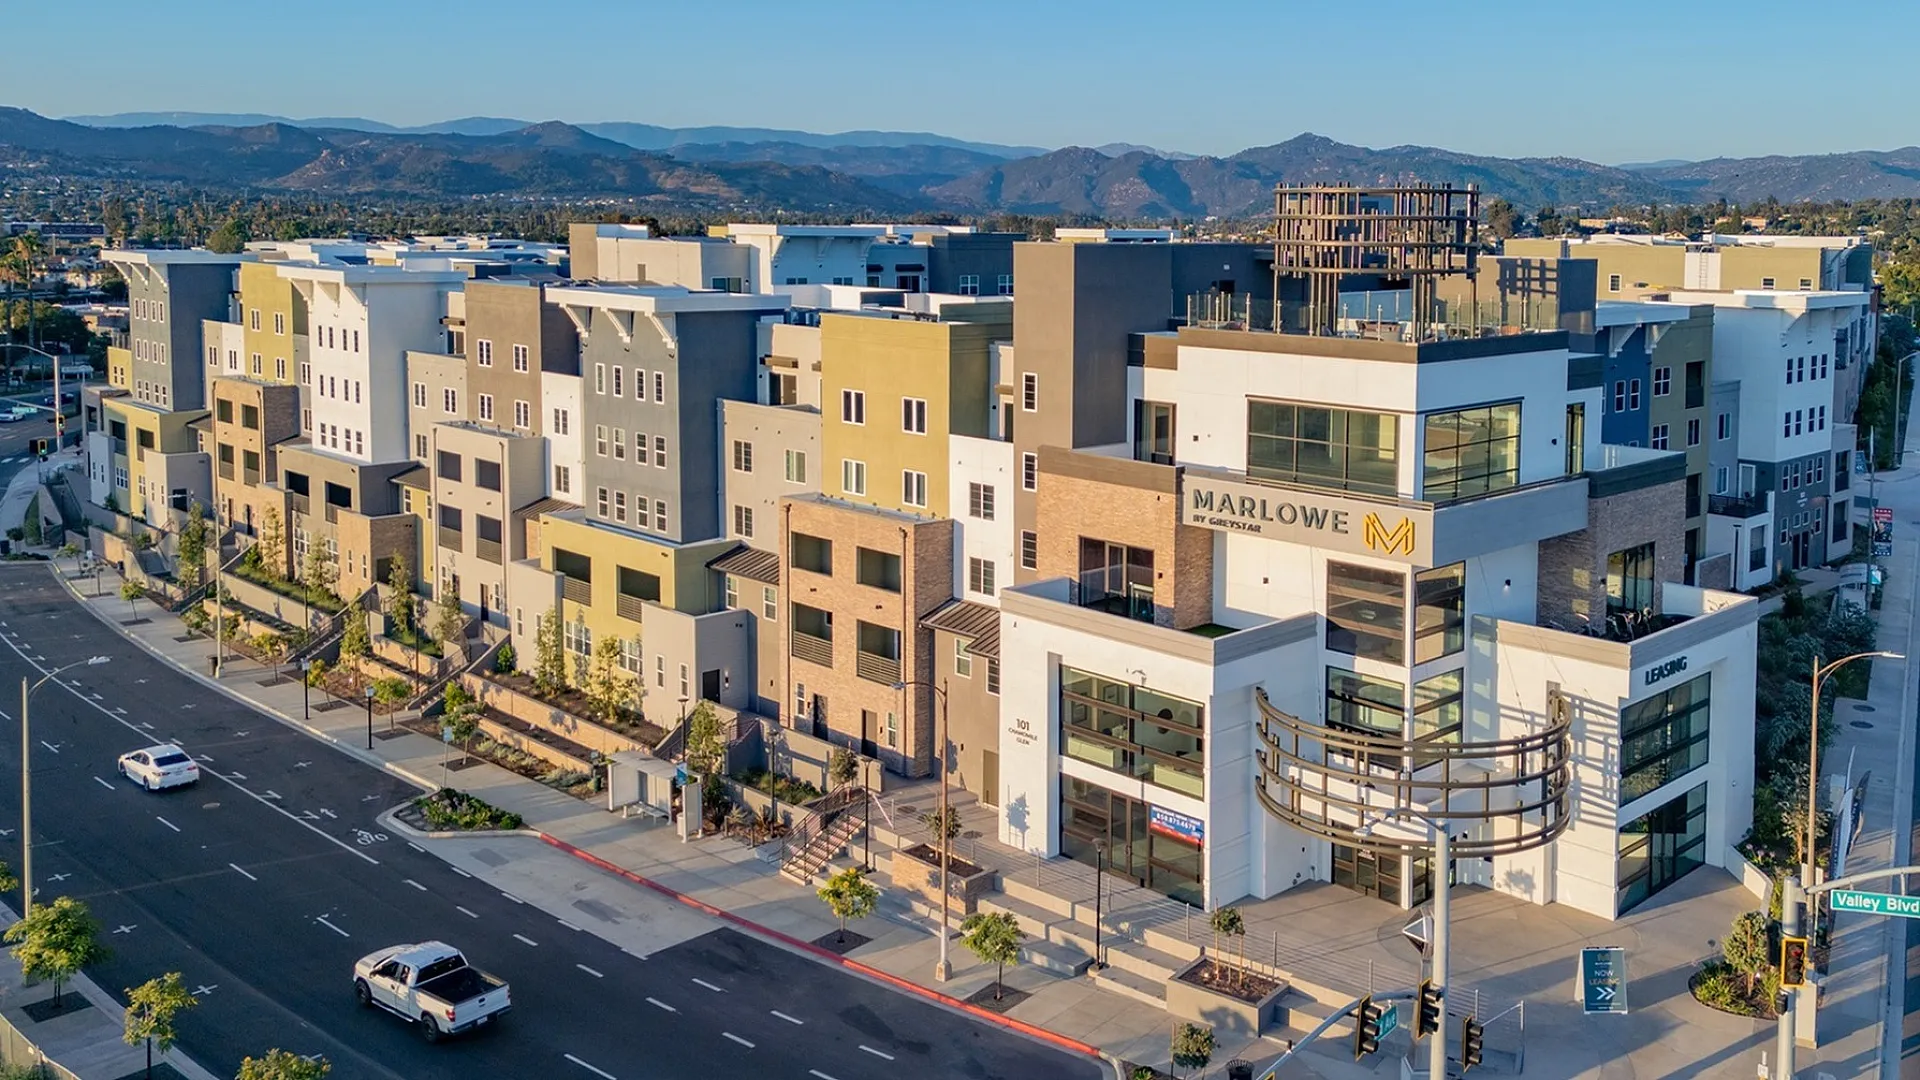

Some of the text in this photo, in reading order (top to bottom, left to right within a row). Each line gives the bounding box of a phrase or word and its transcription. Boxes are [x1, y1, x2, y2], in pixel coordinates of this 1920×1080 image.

[1193, 489, 1349, 534] MARLOWE
[1193, 514, 1262, 533] BY GREYSTAR
[1645, 656, 1687, 685] LEASING
[1016, 718, 1030, 731] 101
[1836, 892, 1920, 913] Valley Blvd
